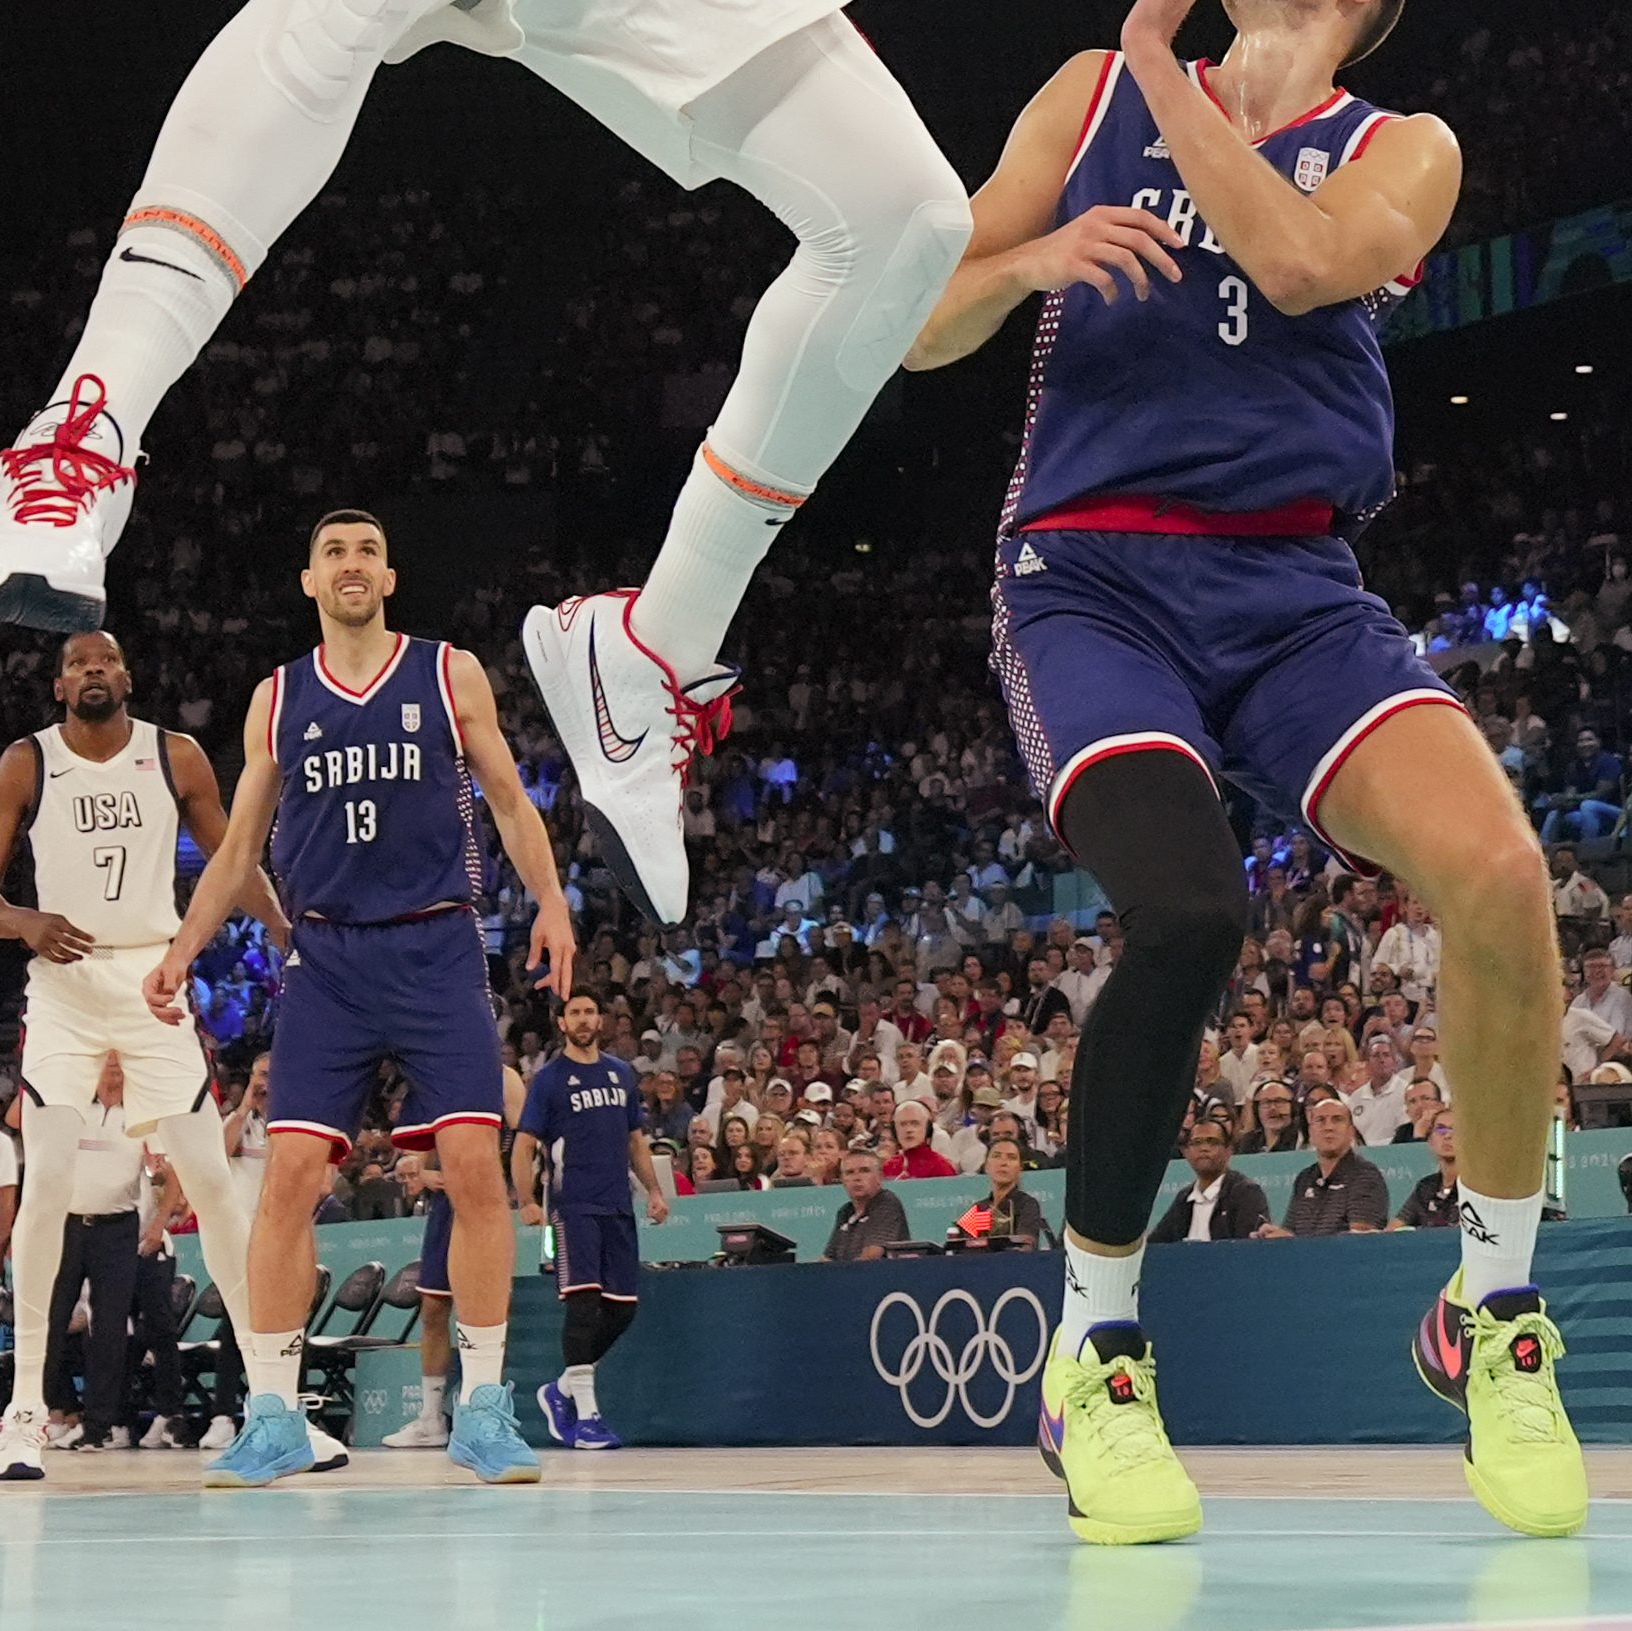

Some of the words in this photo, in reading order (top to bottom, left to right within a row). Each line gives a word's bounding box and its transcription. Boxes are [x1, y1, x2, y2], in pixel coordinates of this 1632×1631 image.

[1142, 146, 1170, 159] PEA
[1218, 275, 1248, 345] 3
[1014, 557, 1048, 577] PEAK
[304, 742, 421, 793] SRBIJA
[73, 790, 142, 833] USA
[344, 799, 377, 844] 13
[93, 845, 126, 901] 7
[570, 1087, 628, 1112] SRBIJA
